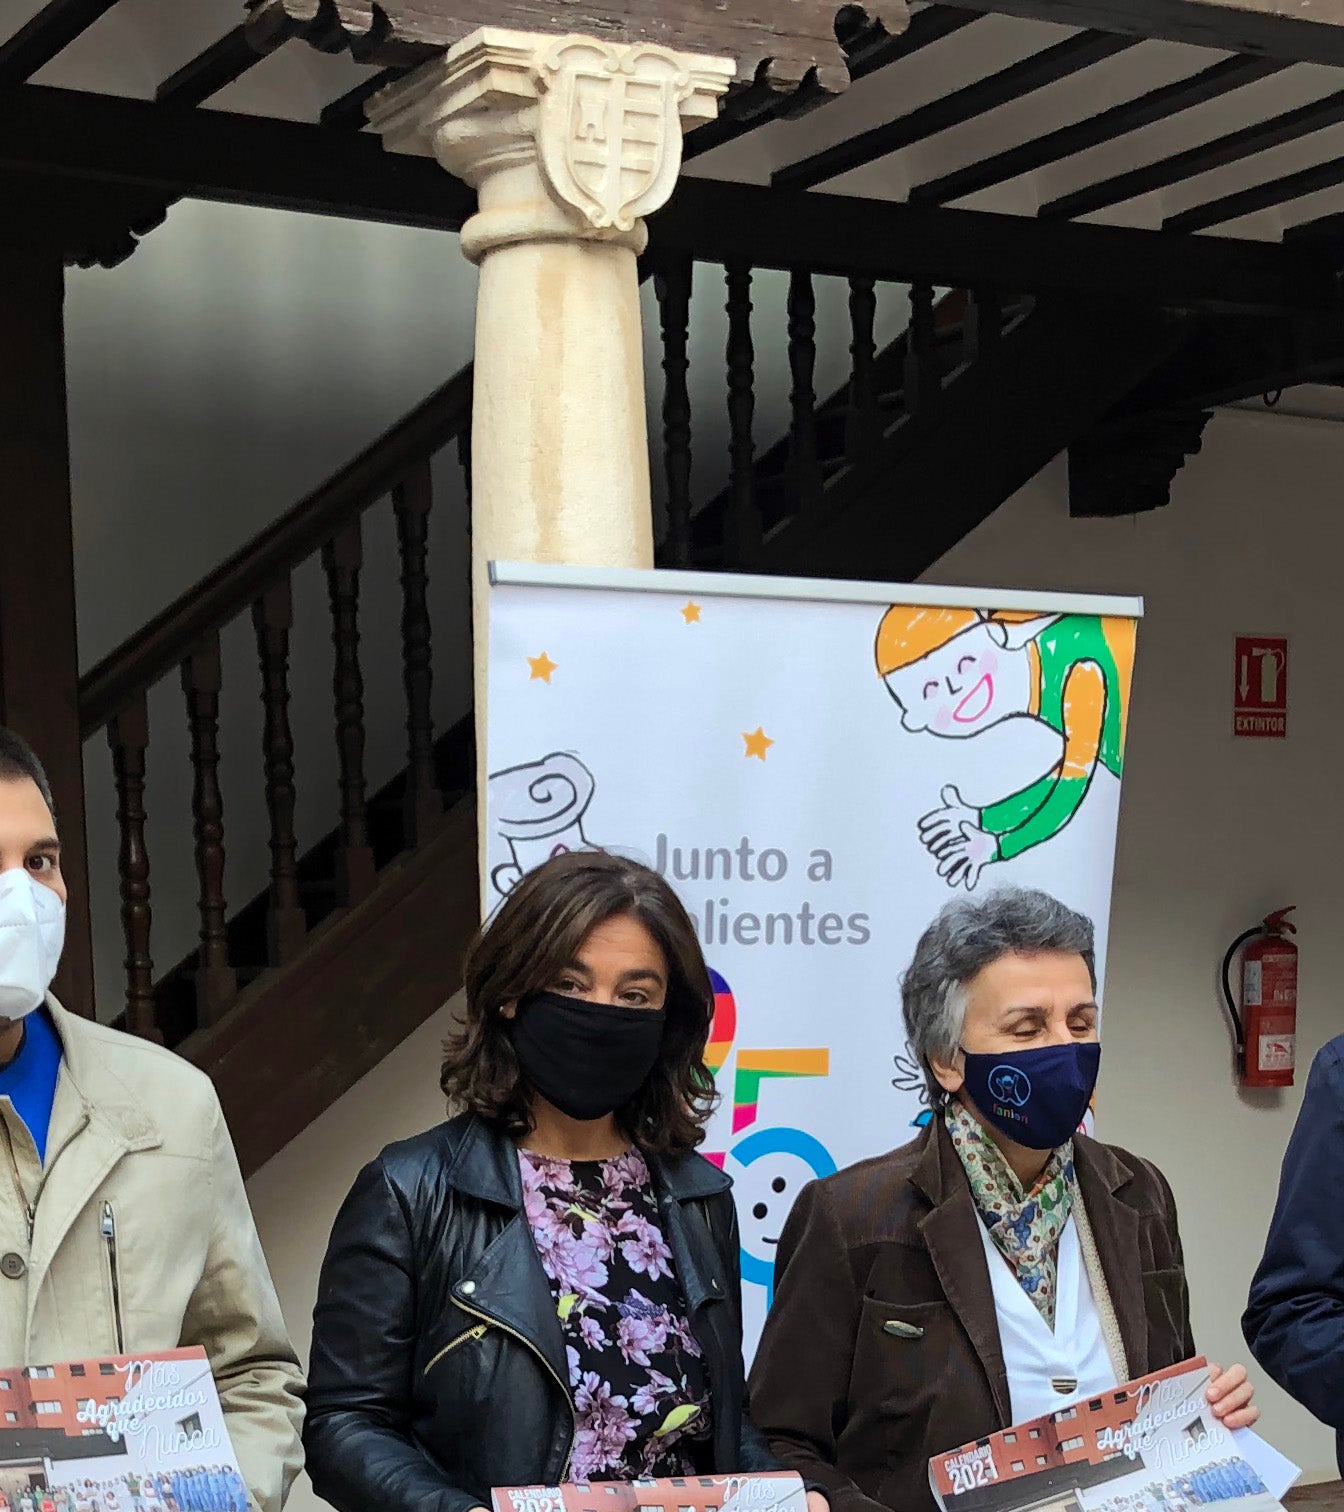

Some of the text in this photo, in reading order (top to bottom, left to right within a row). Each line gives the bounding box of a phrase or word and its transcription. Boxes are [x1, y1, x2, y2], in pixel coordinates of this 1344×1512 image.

[1236, 717, 1284, 732] EXTINTOR
[807, 848, 832, 882] a
[688, 898, 871, 946] lientes
[76, 1389, 209, 1427] Agradecidos
[1096, 1397, 1208, 1450] Agradecidos
[106, 1418, 143, 1443] que
[140, 1424, 221, 1463] Nunca
[1123, 1435, 1154, 1460] que
[1156, 1428, 1225, 1469] Nunca
[508, 1487, 563, 1501] CALENDARIO
[948, 1455, 999, 1496] 2021
